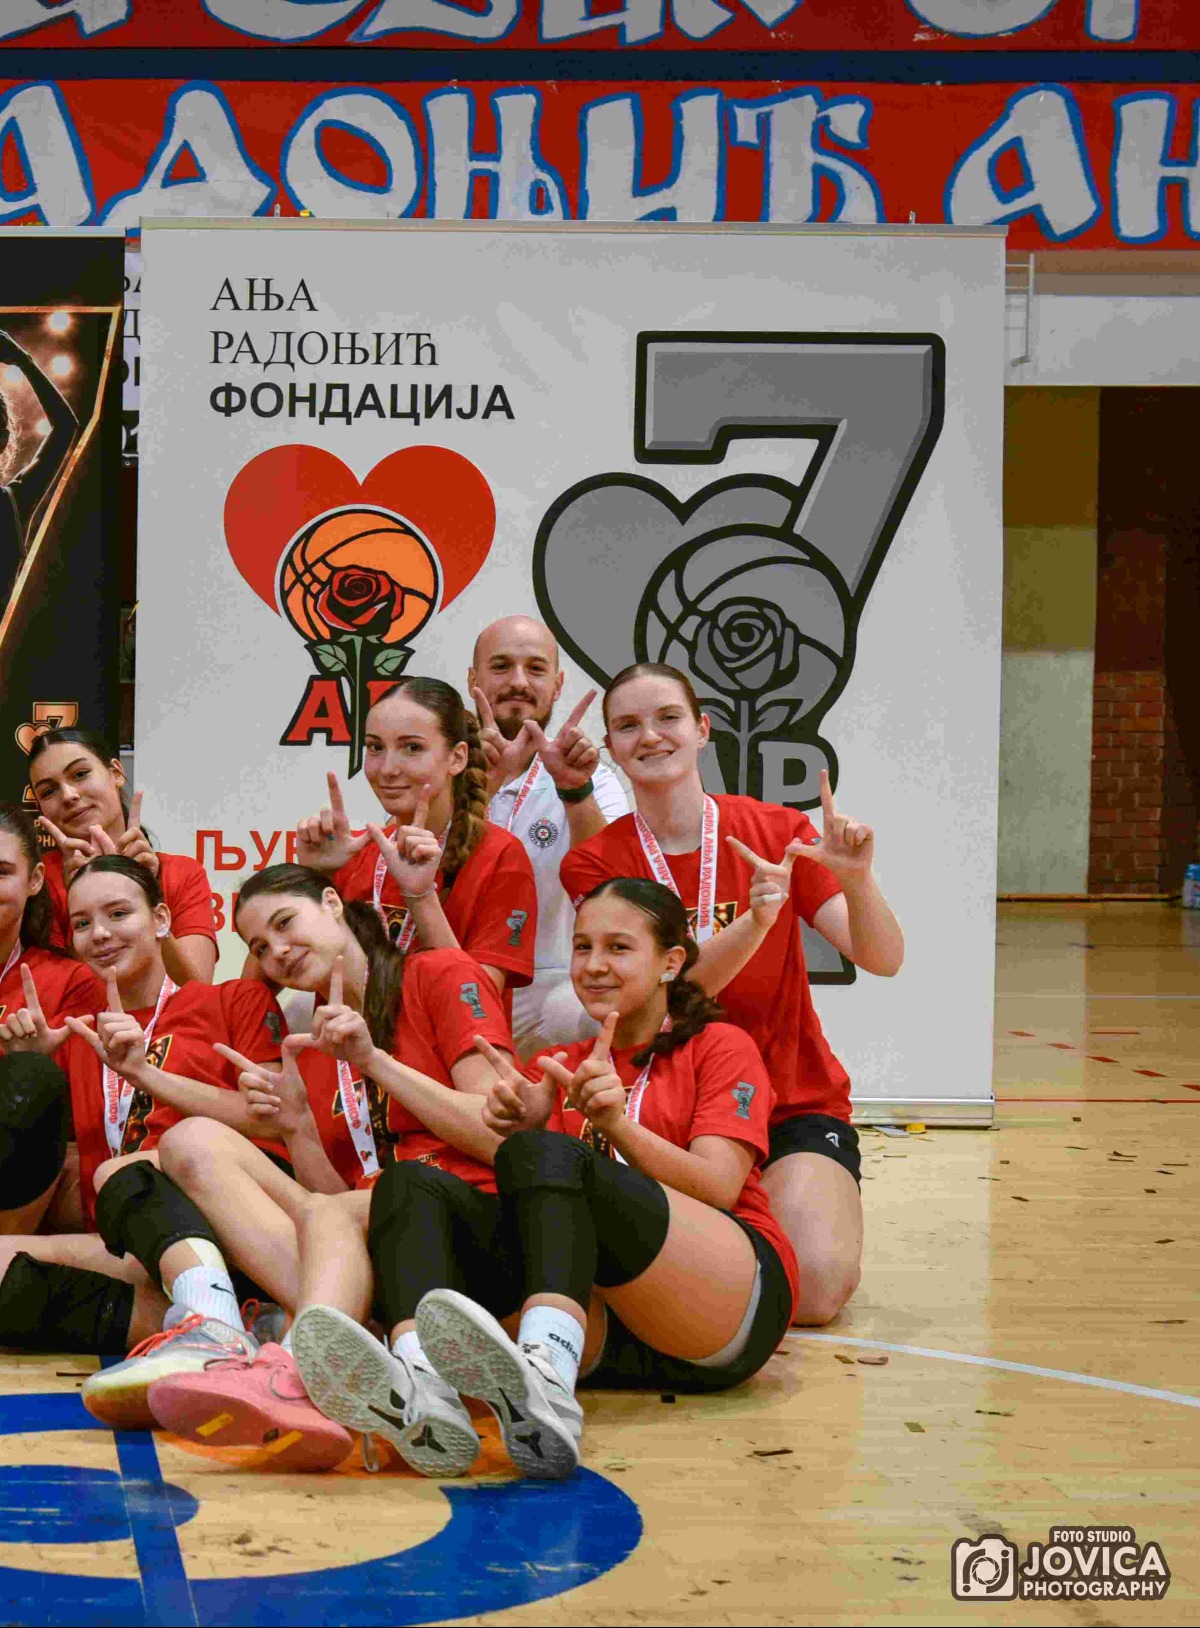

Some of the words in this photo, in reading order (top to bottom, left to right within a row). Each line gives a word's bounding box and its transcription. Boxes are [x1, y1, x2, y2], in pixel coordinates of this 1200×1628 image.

[209, 277, 318, 312] АЊА
[209, 331, 440, 370] РАДОЊИЋ
[209, 381, 516, 425] ФОНДАЦИЈА
